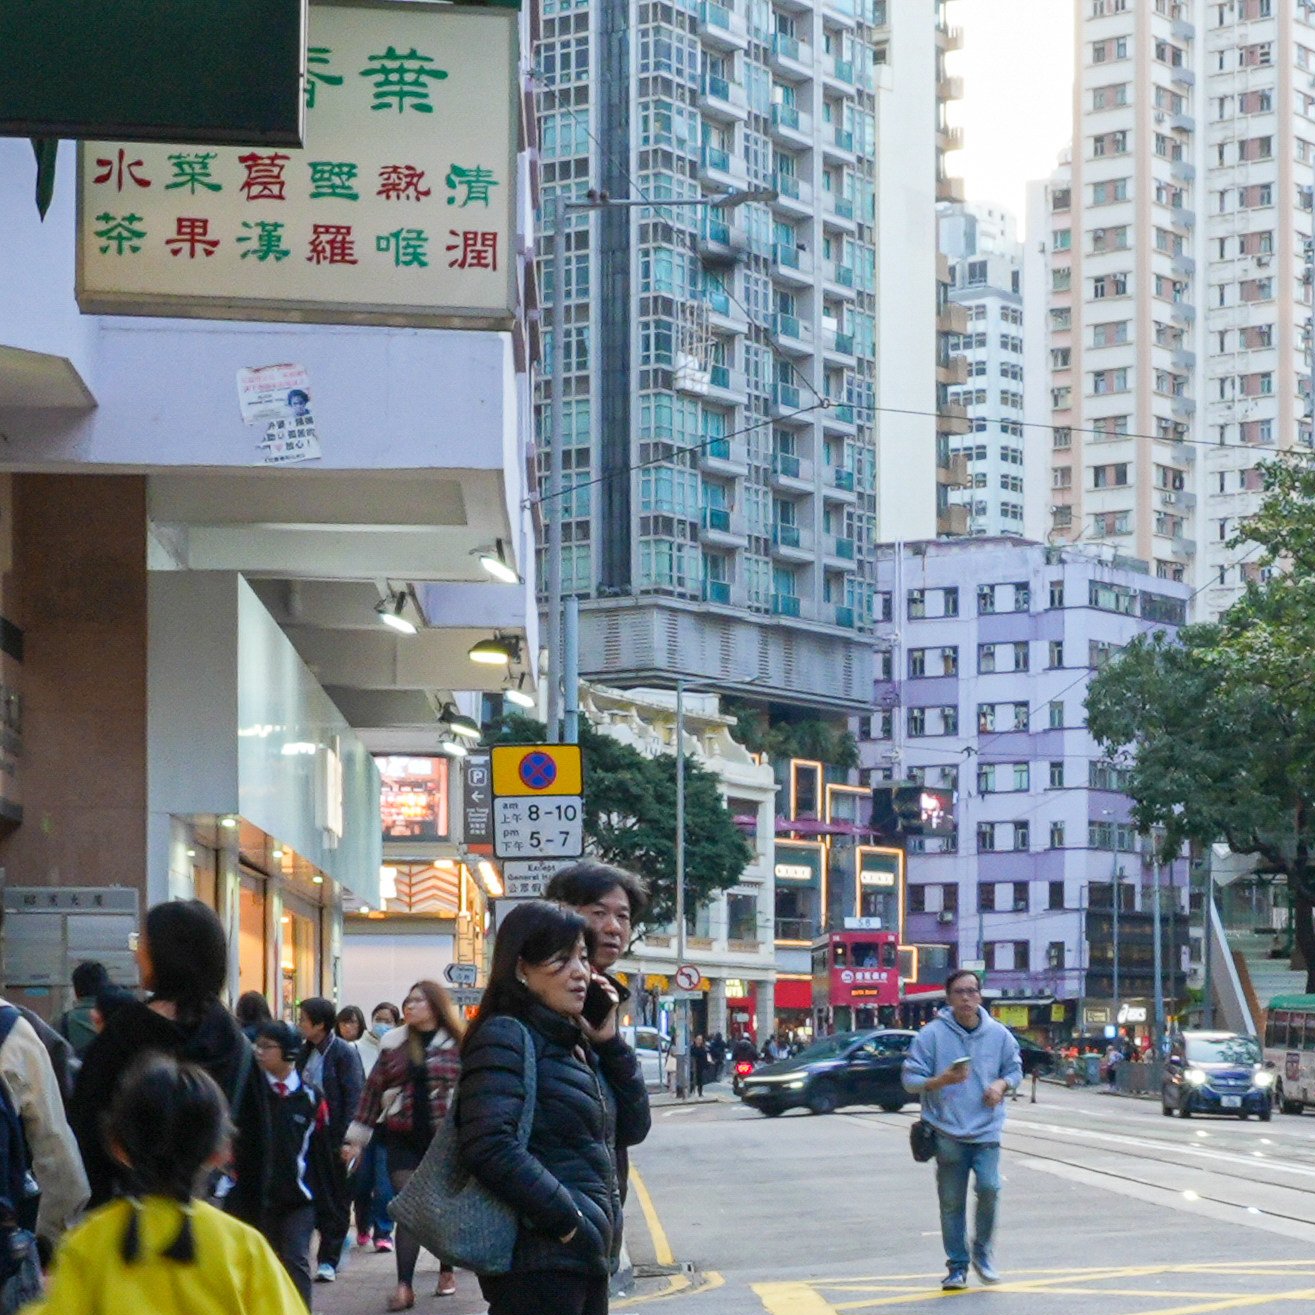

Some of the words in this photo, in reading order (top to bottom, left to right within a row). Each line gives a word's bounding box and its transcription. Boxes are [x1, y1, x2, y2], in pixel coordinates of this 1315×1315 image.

[502, 802, 519, 810] am
[500, 813, 523, 825] 上午
[502, 829, 520, 839] pm
[501, 841, 524, 853] 下午
